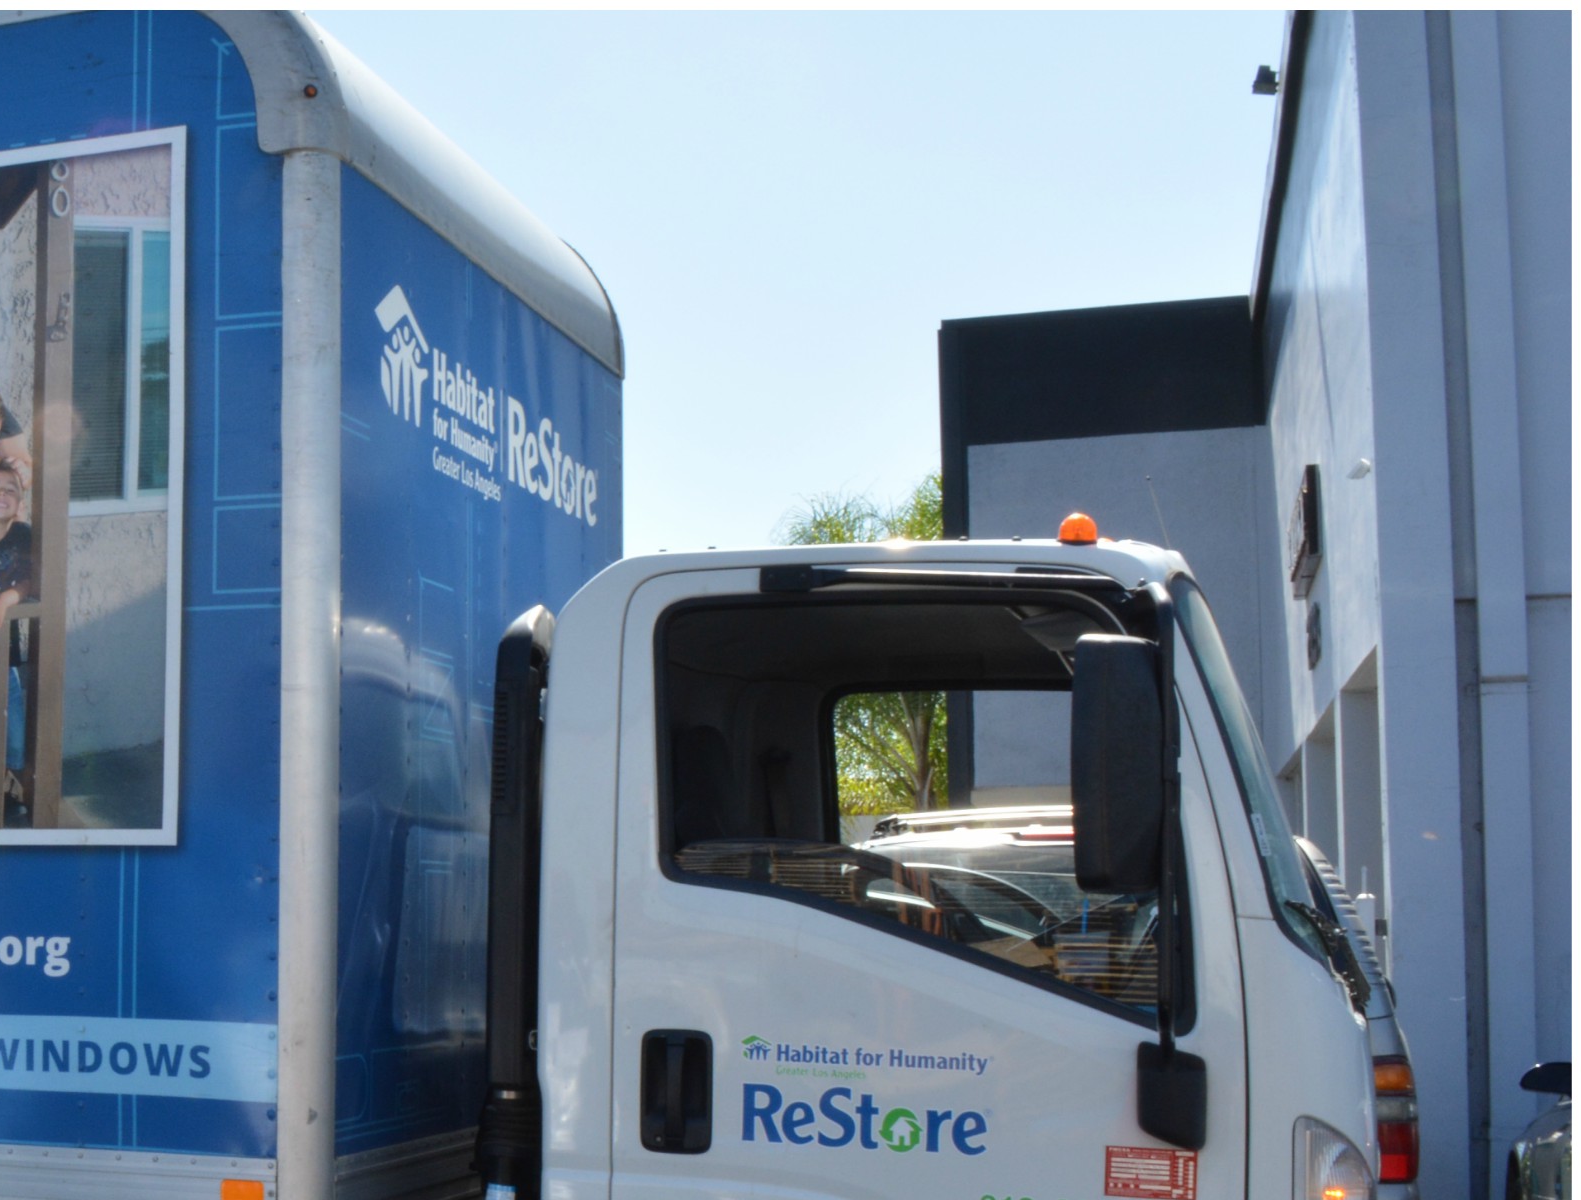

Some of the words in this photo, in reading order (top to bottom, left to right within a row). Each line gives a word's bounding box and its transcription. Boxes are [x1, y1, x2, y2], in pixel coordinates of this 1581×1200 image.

[433, 347, 495, 434] Habitat
[432, 408, 448, 442] for
[451, 417, 494, 473] Humanity
[507, 395, 597, 527] ReStore
[432, 446, 461, 479] Greater
[461, 462, 474, 488] Los
[474, 469, 501, 501] Angeles
[775, 1043, 849, 1065] Habitat
[855, 1047, 883, 1067] for
[889, 1049, 989, 1076] Humanity
[775, 1065, 809, 1077] Greater
[812, 1067, 829, 1078] Los
[831, 1069, 867, 1080] Angeles
[741, 1083, 988, 1156] ReStore
